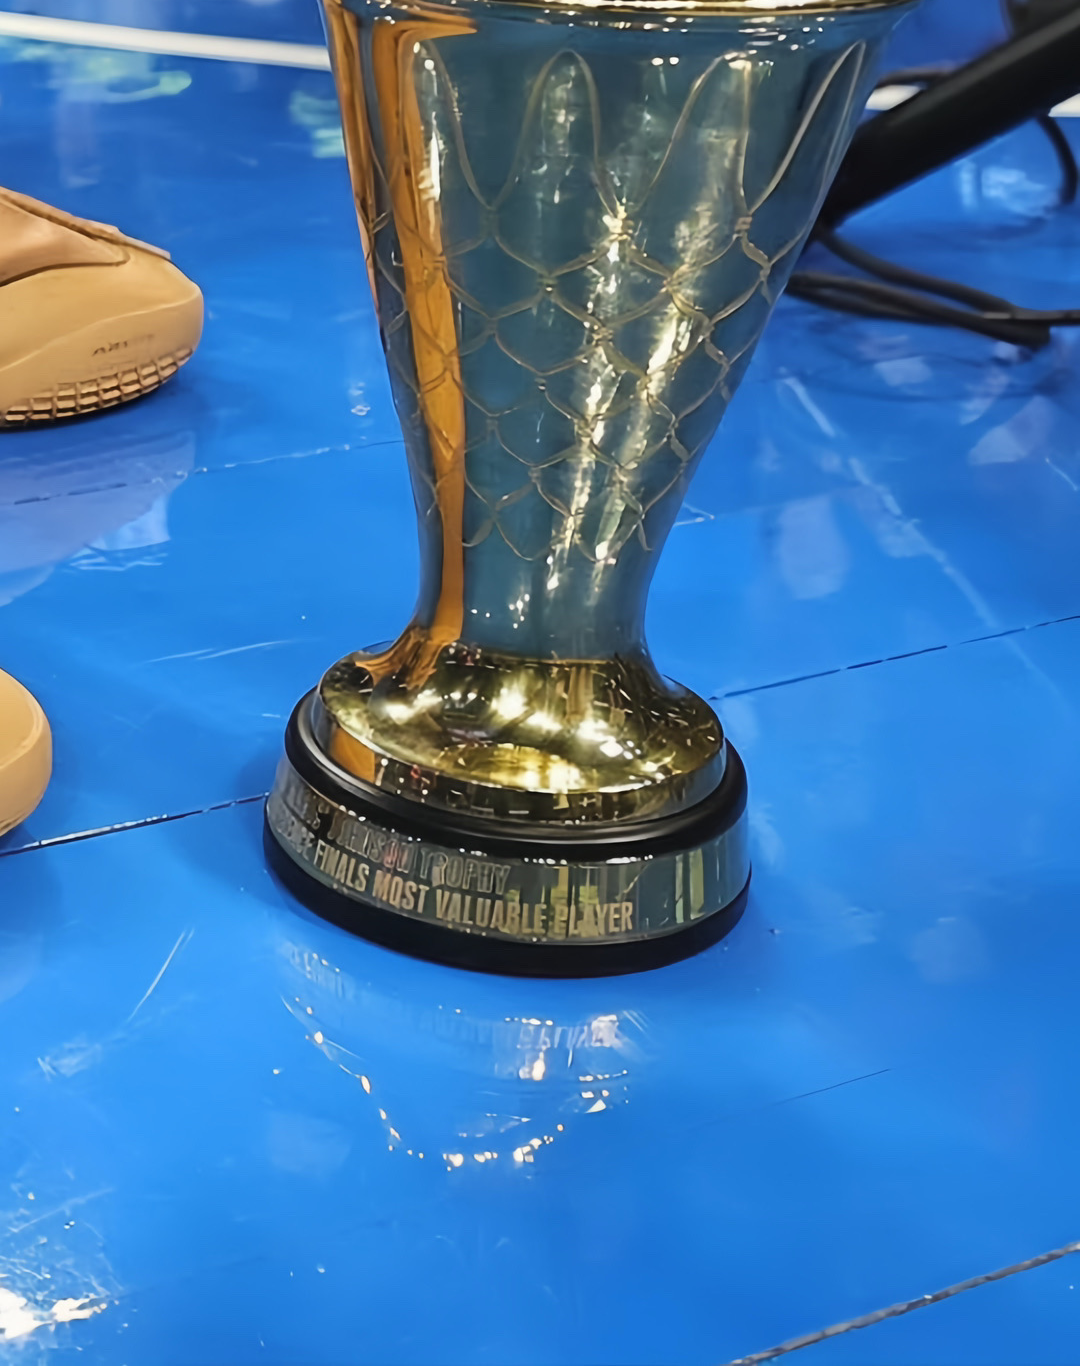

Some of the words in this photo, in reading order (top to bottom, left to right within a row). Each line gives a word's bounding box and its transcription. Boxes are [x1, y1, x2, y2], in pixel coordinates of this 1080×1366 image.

[313, 838, 370, 892] FINALS
[372, 869, 430, 914] MOST
[436, 888, 547, 935] VALUABLE
[553, 902, 633, 937] PLAYER
[420, 847, 512, 895] TROPHY
